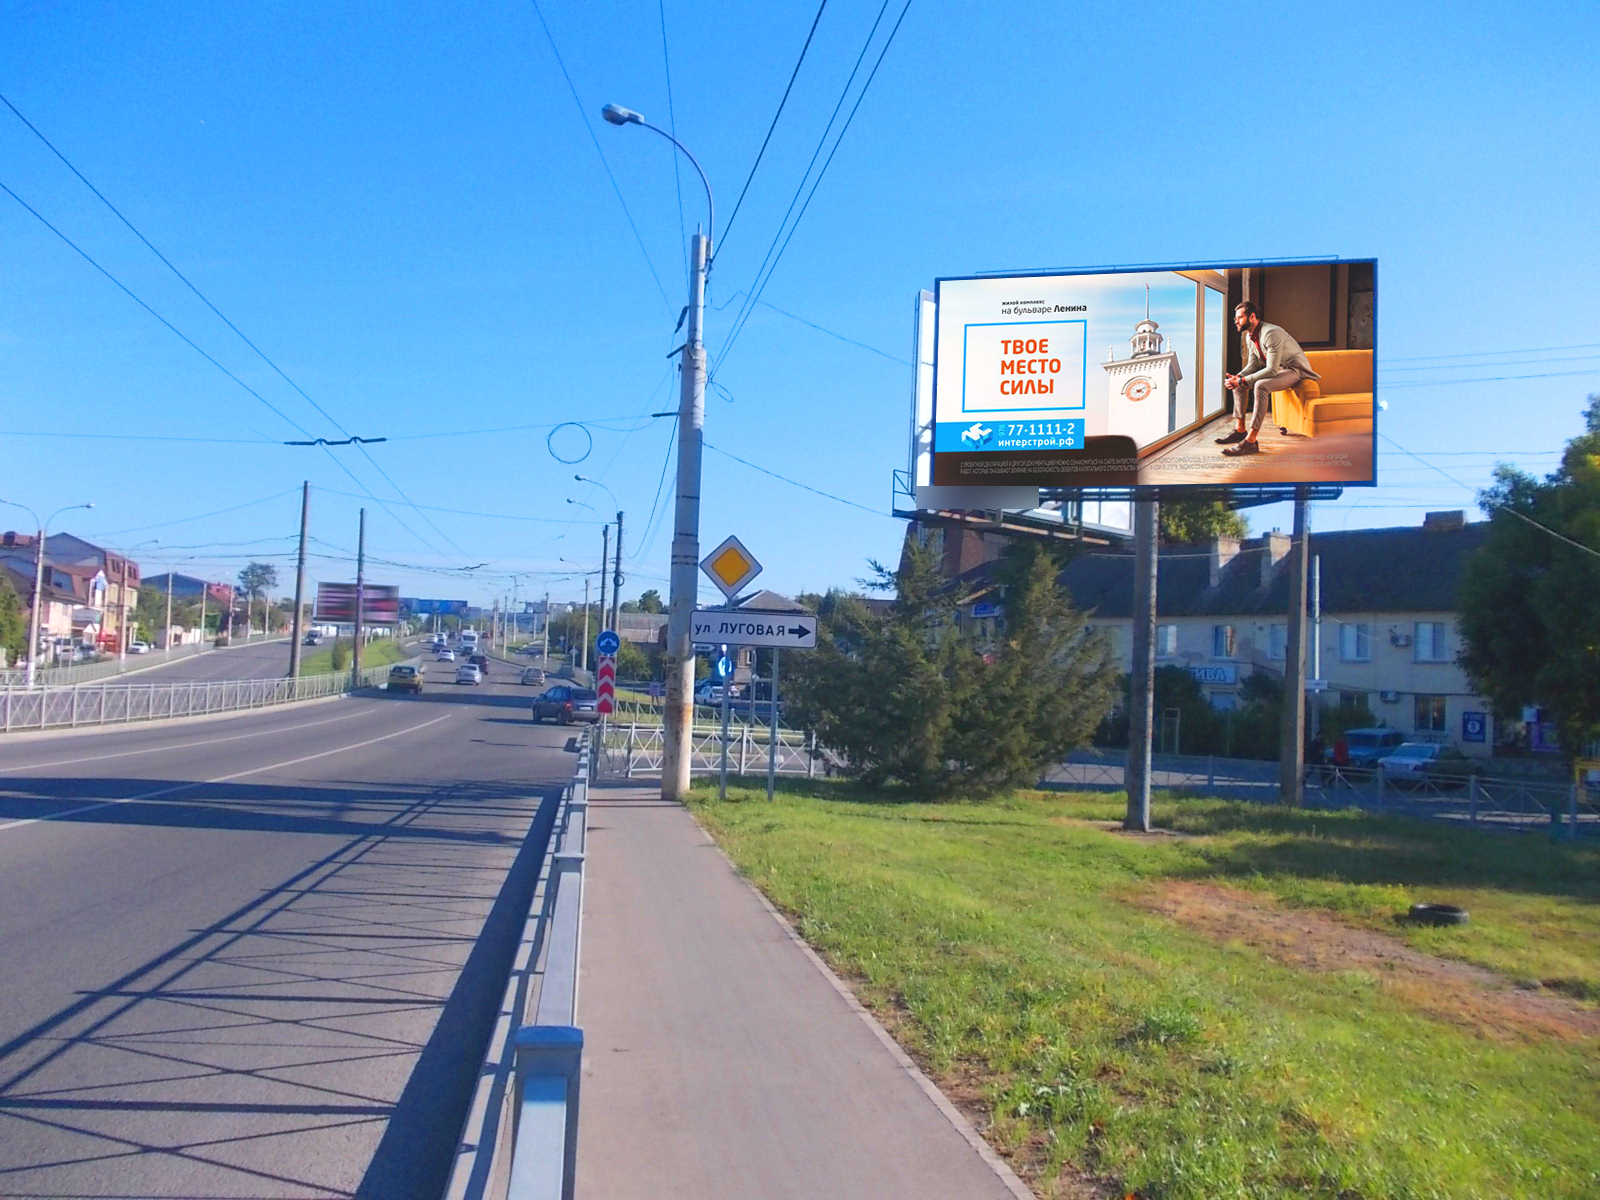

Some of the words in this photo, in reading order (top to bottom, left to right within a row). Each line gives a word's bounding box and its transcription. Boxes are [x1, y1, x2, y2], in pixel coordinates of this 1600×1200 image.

[1001, 307, 1012, 315] на
[1013, 306, 1052, 316] бульваре
[1053, 304, 1087, 313] Ленина
[1000, 338, 1049, 355] ТВОЕ
[1000, 358, 1062, 375] МЕСТО
[1000, 379, 1054, 396] СИЛЫ
[1008, 423, 1075, 436] 77-1111-2
[998, 437, 1075, 448] интерстрой.рф
[695, 624, 715, 635] ул.
[718, 622, 785, 636] ЛУГОВАЯ
